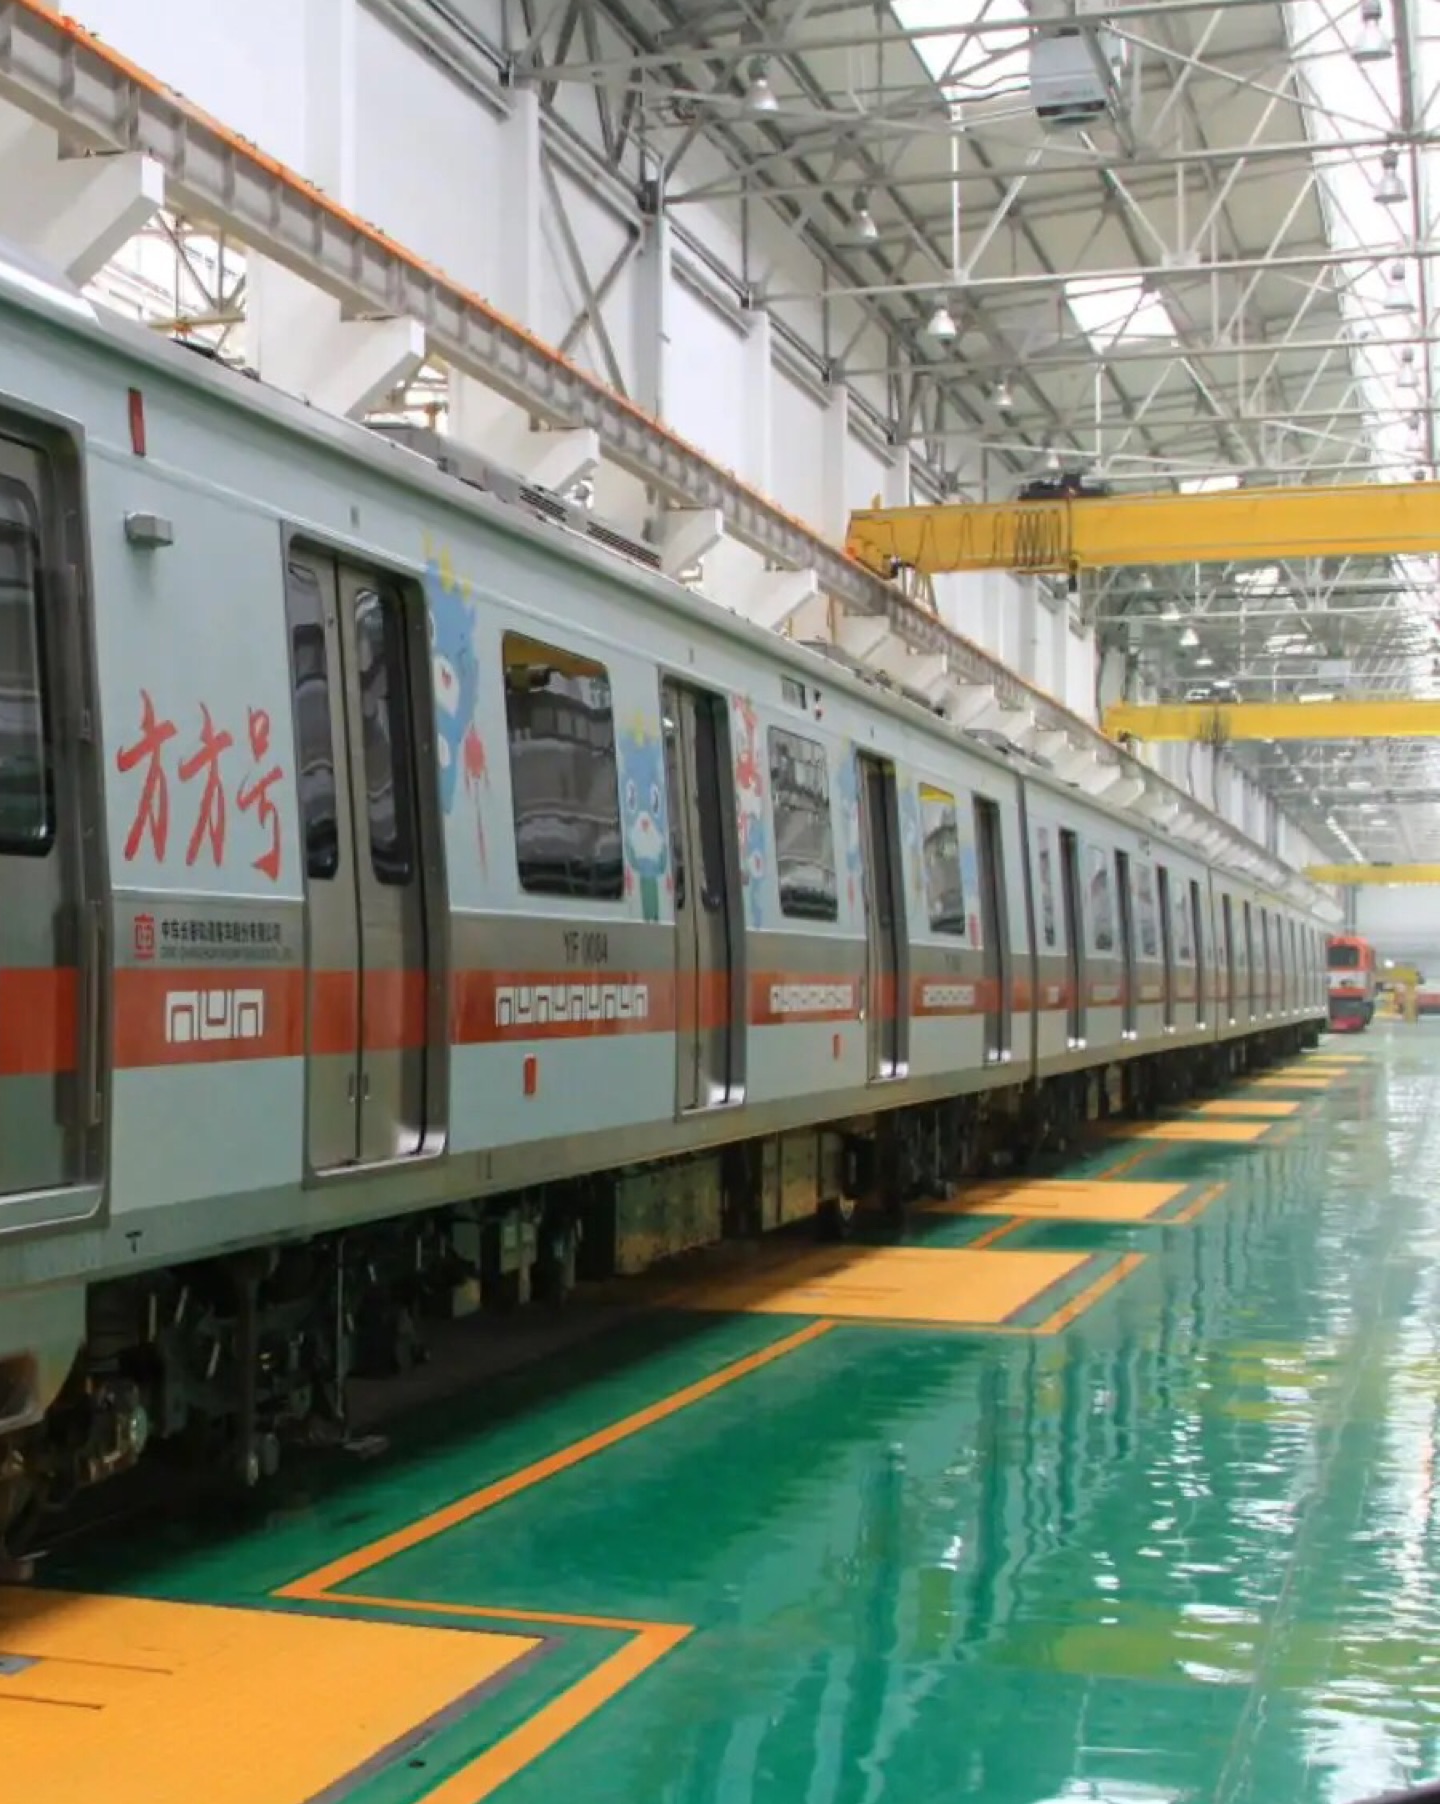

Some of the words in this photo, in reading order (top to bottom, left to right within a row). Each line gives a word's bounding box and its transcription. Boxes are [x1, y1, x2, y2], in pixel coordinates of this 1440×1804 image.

[116, 688, 284, 881] 方方号
[563, 930, 579, 964] YF
